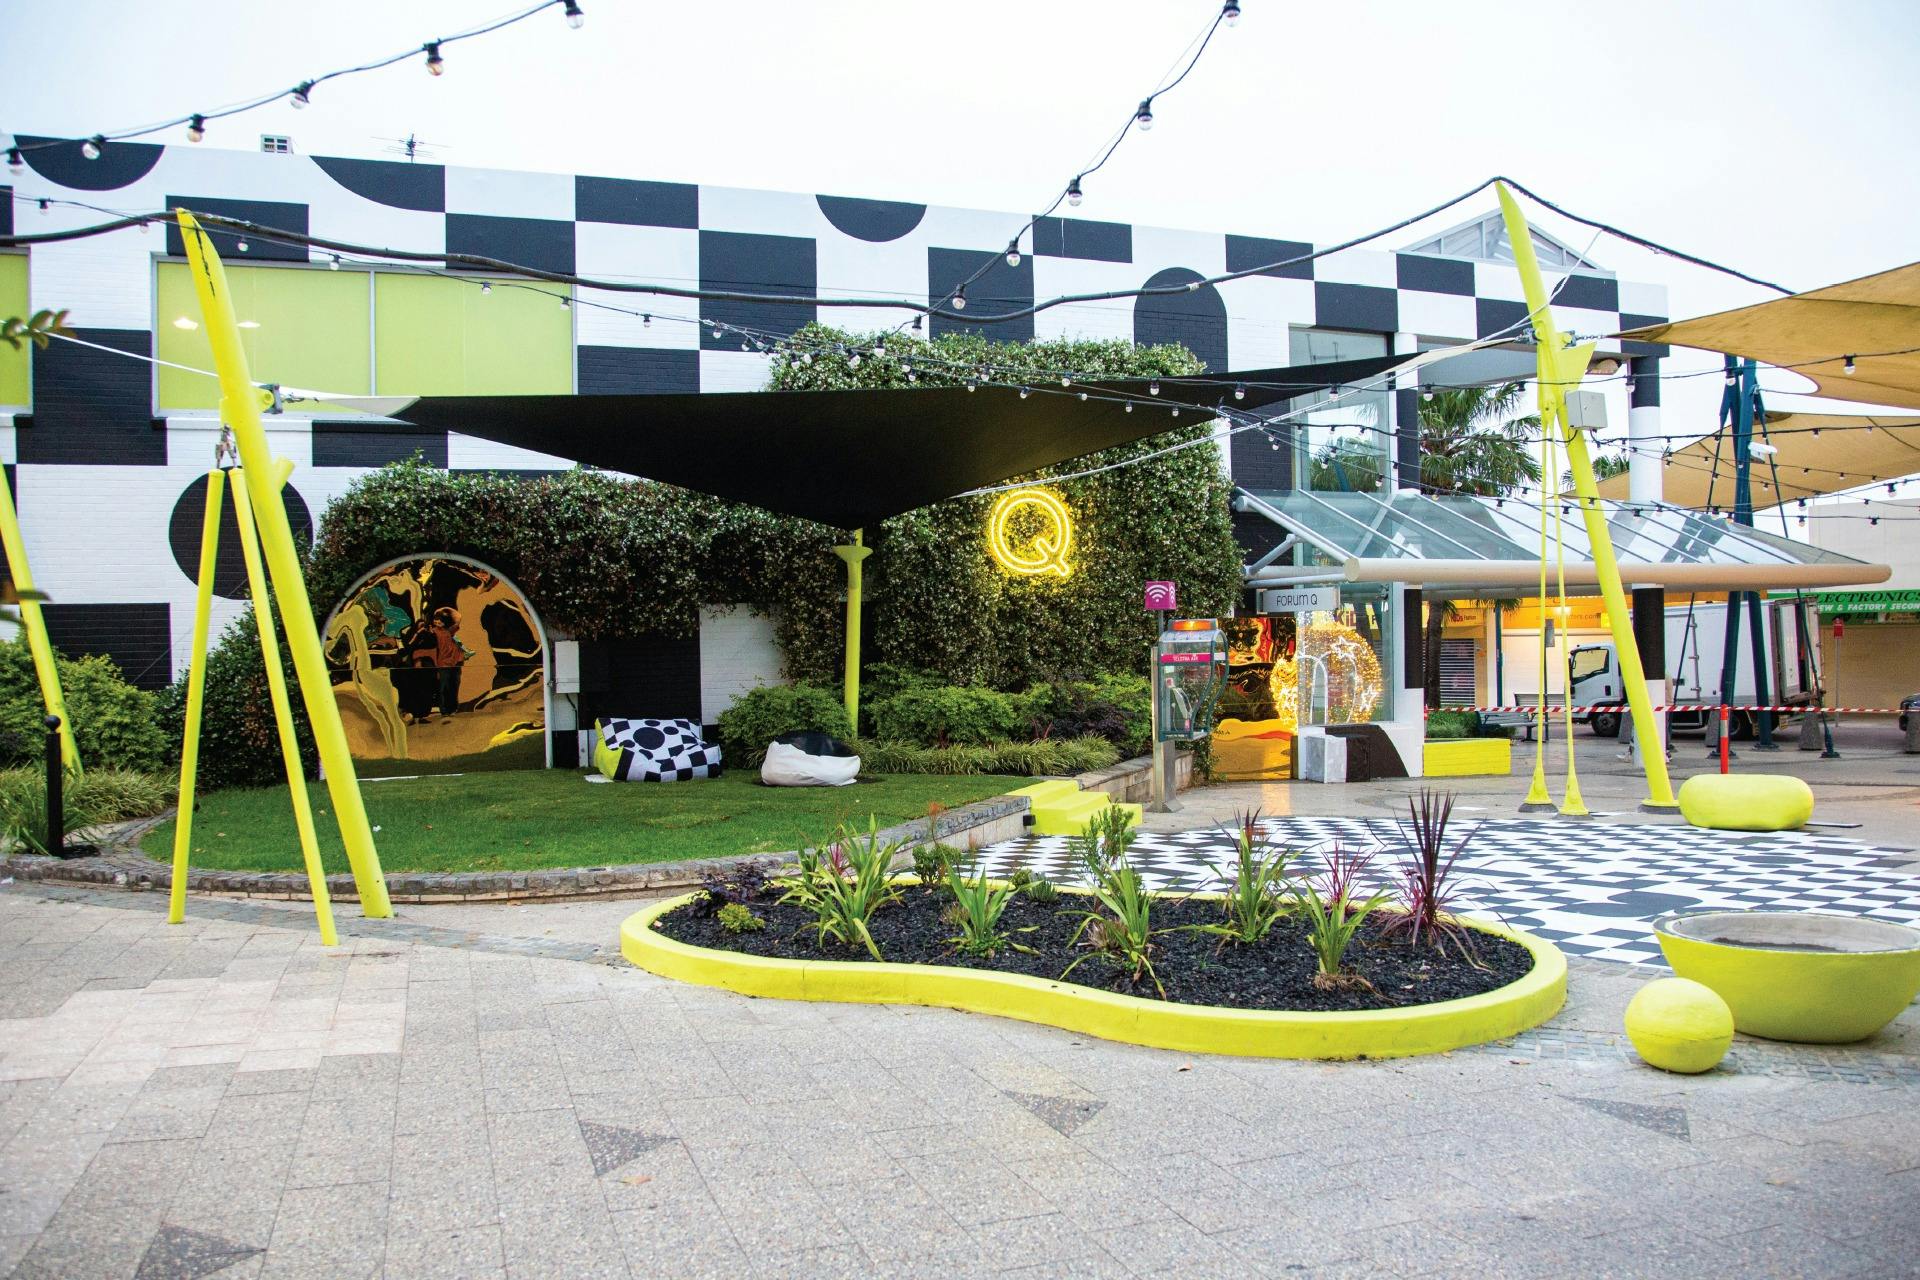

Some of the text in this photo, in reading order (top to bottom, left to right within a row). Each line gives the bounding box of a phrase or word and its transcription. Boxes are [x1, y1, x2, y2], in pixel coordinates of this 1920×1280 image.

[990, 489, 1069, 576] Q
[1276, 593, 1318, 606] FORUM Q
[1808, 592, 1920, 603] LECTRONIC
[1848, 603, 1886, 611] FACTORY
